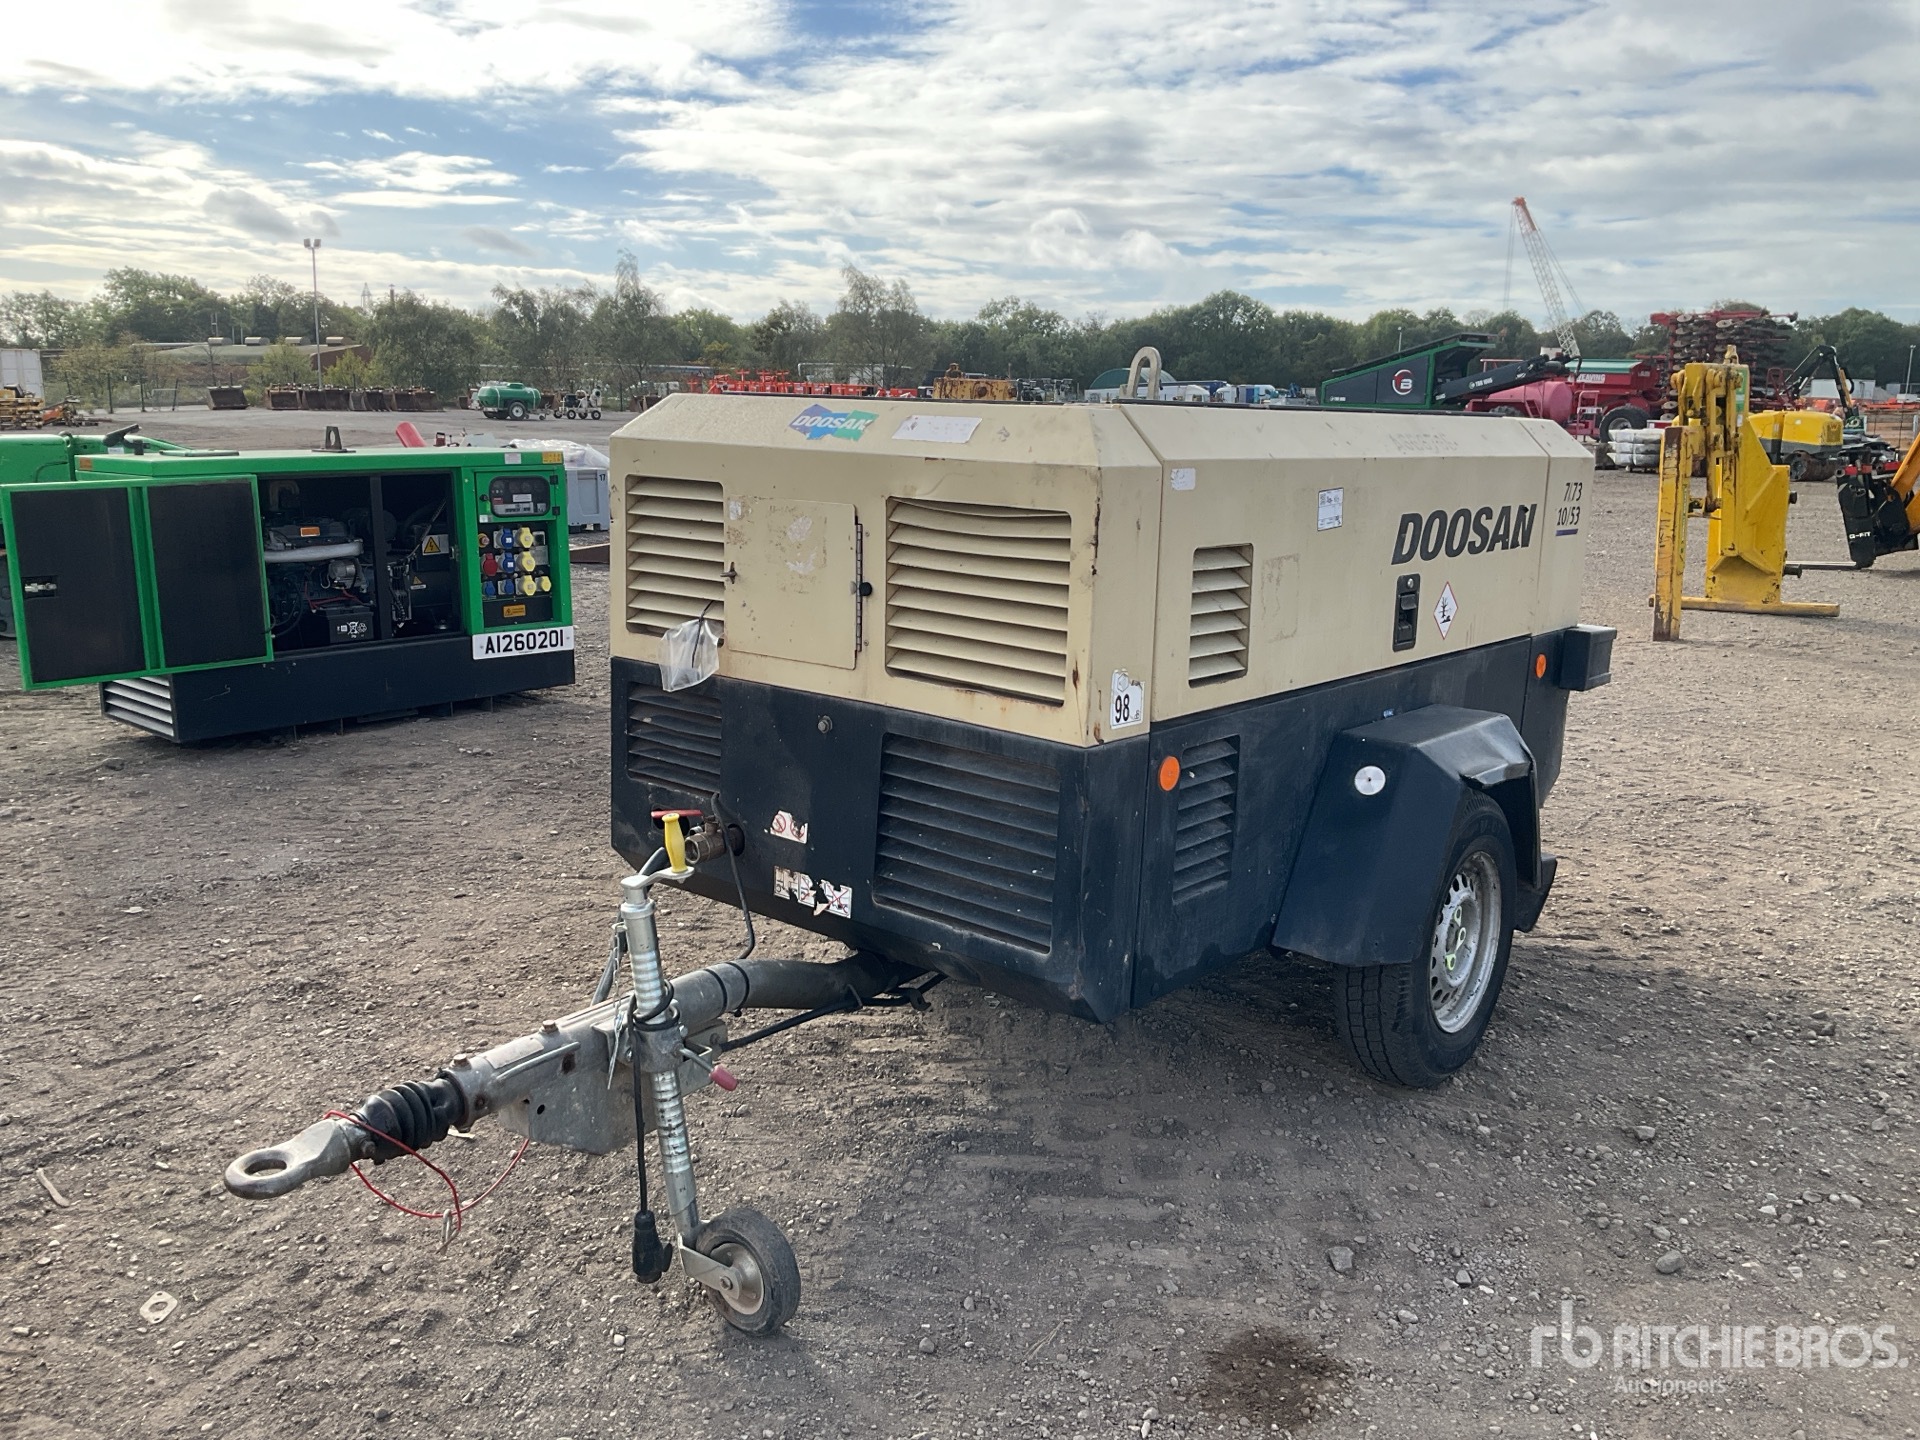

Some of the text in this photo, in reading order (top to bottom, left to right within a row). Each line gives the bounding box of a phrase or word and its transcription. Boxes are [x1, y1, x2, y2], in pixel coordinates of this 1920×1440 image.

[792, 415, 873, 431] DOOSAN
[1557, 506, 1581, 526] 10/53
[1391, 504, 1537, 565] DOOSAN
[1115, 693, 1130, 723] 98
